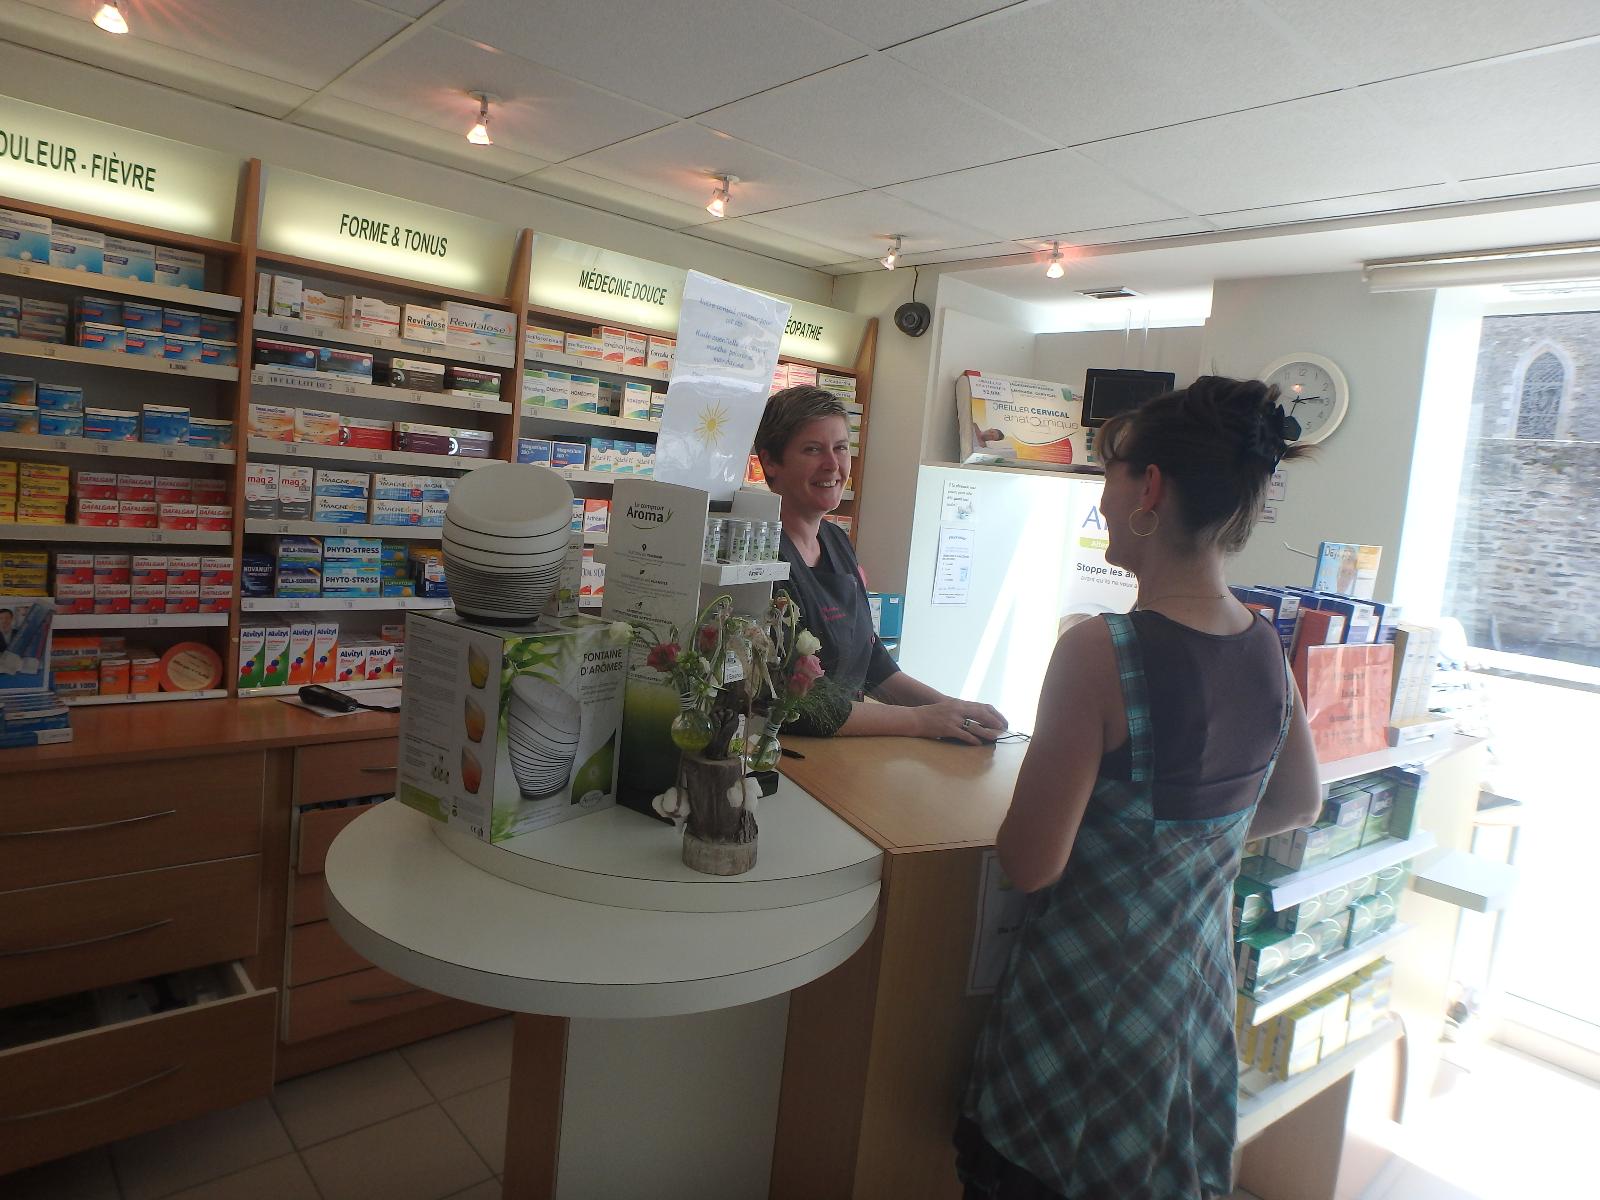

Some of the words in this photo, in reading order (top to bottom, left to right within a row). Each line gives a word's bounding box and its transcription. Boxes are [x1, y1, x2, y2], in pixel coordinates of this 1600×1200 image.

[91, 152, 157, 193] FIÈVRE
[339, 213, 390, 245] FORME
[391, 226, 400, 248] &
[404, 228, 448, 258] TONUS
[578, 268, 633, 298] MÉDECINE
[632, 282, 668, 306] DOUCE
[407, 315, 446, 330] Revitalose
[449, 317, 506, 334] Revitalose
[1031, 407, 1071, 419] CERVICAL
[247, 476, 266, 486] mag
[267, 476, 274, 484] 2
[281, 478, 300, 489] mag
[300, 478, 307, 486] 2
[81, 503, 118, 511] DAFALGAN
[162, 507, 196, 515] DAFALGAN
[626, 506, 664, 523] Aroma
[1076, 562, 1108, 578] Stoppe
[1109, 567, 1123, 578] les
[292, 628, 314, 637] Alvityl
[316, 628, 337, 637] Alvityl
[340, 650, 364, 659] Alvityl
[369, 649, 393, 658] Alvityl
[583, 648, 623, 664] FONTAINE
[580, 661, 623, 677] D'ARÔMES
